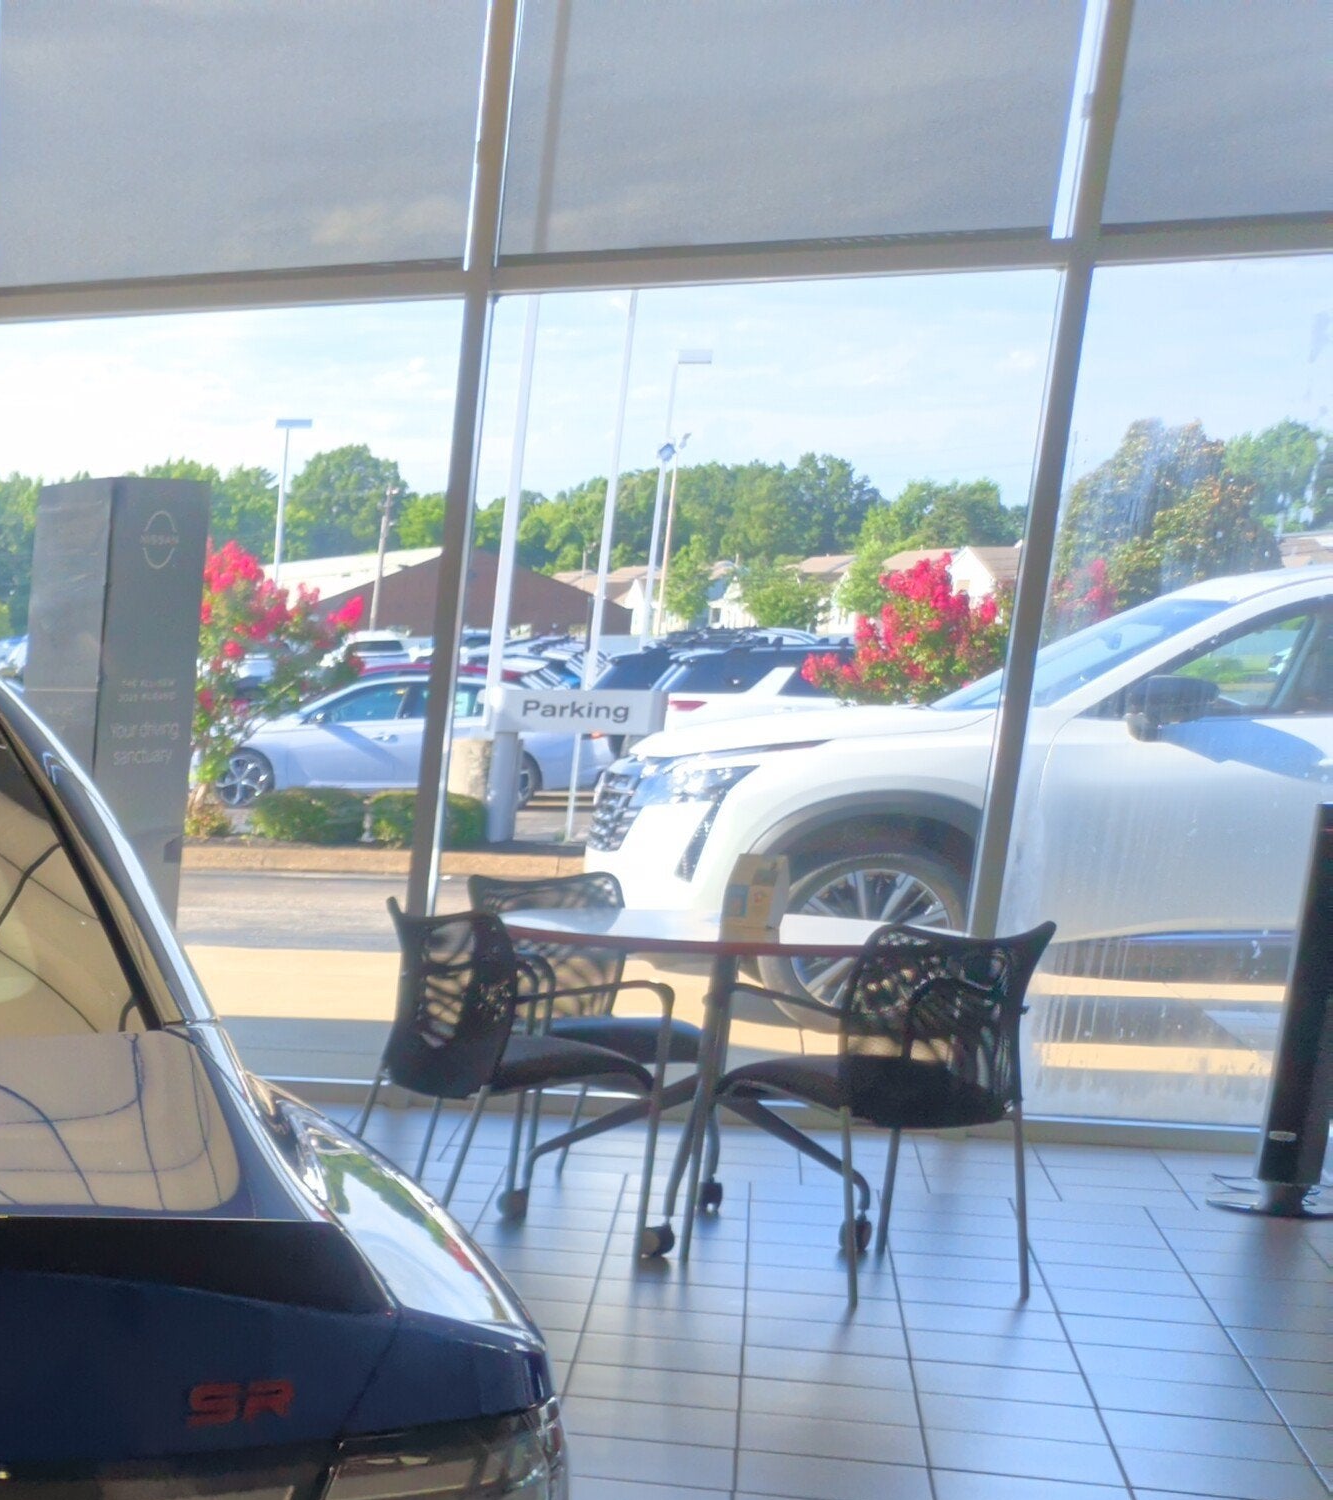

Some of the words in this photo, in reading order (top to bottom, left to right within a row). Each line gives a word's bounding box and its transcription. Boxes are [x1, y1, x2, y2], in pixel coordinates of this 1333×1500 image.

[522, 700, 630, 724] Parking
[113, 750, 173, 767] sanctuary
[187, 1378, 295, 1429] SR
